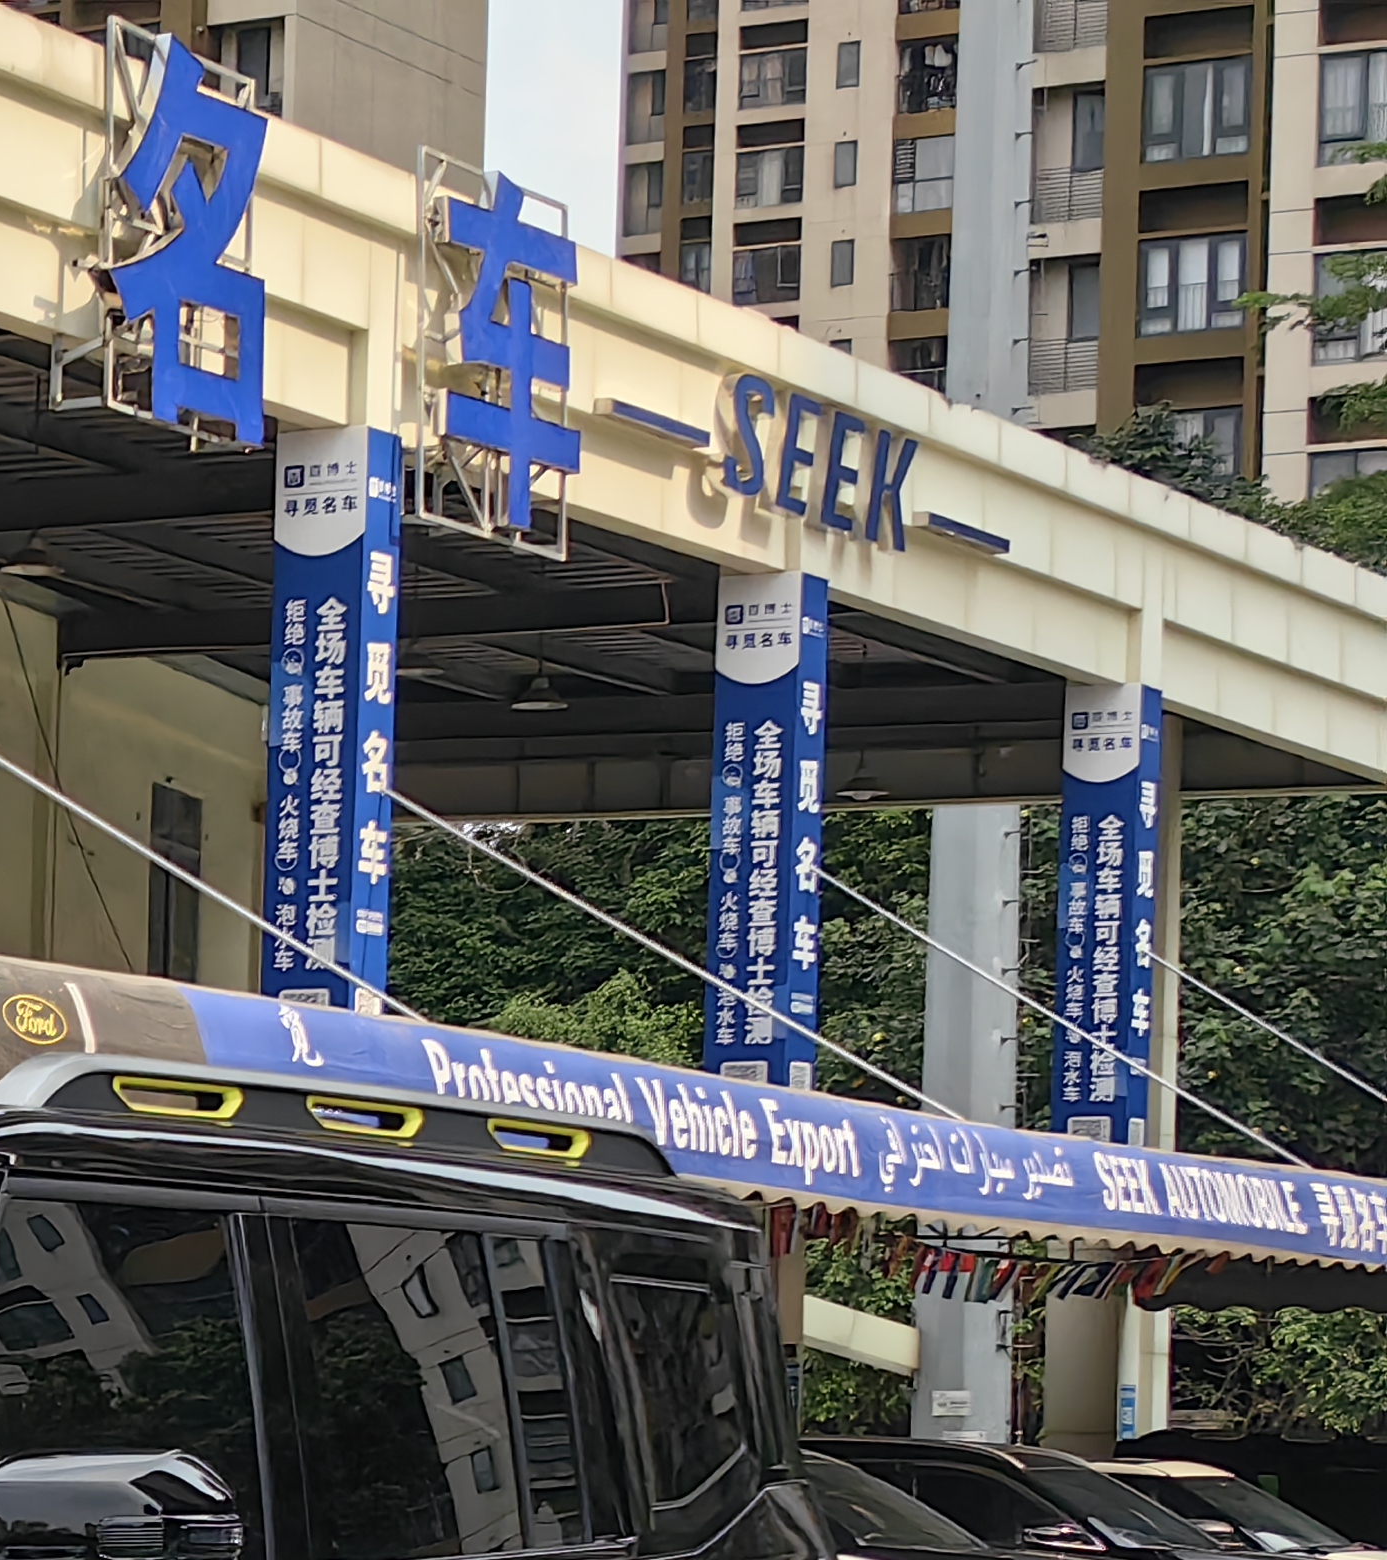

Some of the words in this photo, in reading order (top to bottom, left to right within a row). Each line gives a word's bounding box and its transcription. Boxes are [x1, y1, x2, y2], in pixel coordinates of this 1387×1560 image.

[722, 374, 917, 553] SEEK
[357, 550, 396, 886] 寻觅名车
[15, 999, 58, 1037] Ford
[420, 1039, 632, 1124] Professional
[635, 1076, 759, 1160] Vehicle
[759, 1097, 863, 1186] Export
[1093, 1150, 1163, 1216] SEEK
[1158, 1162, 1310, 1236] AUTOMOBILE
